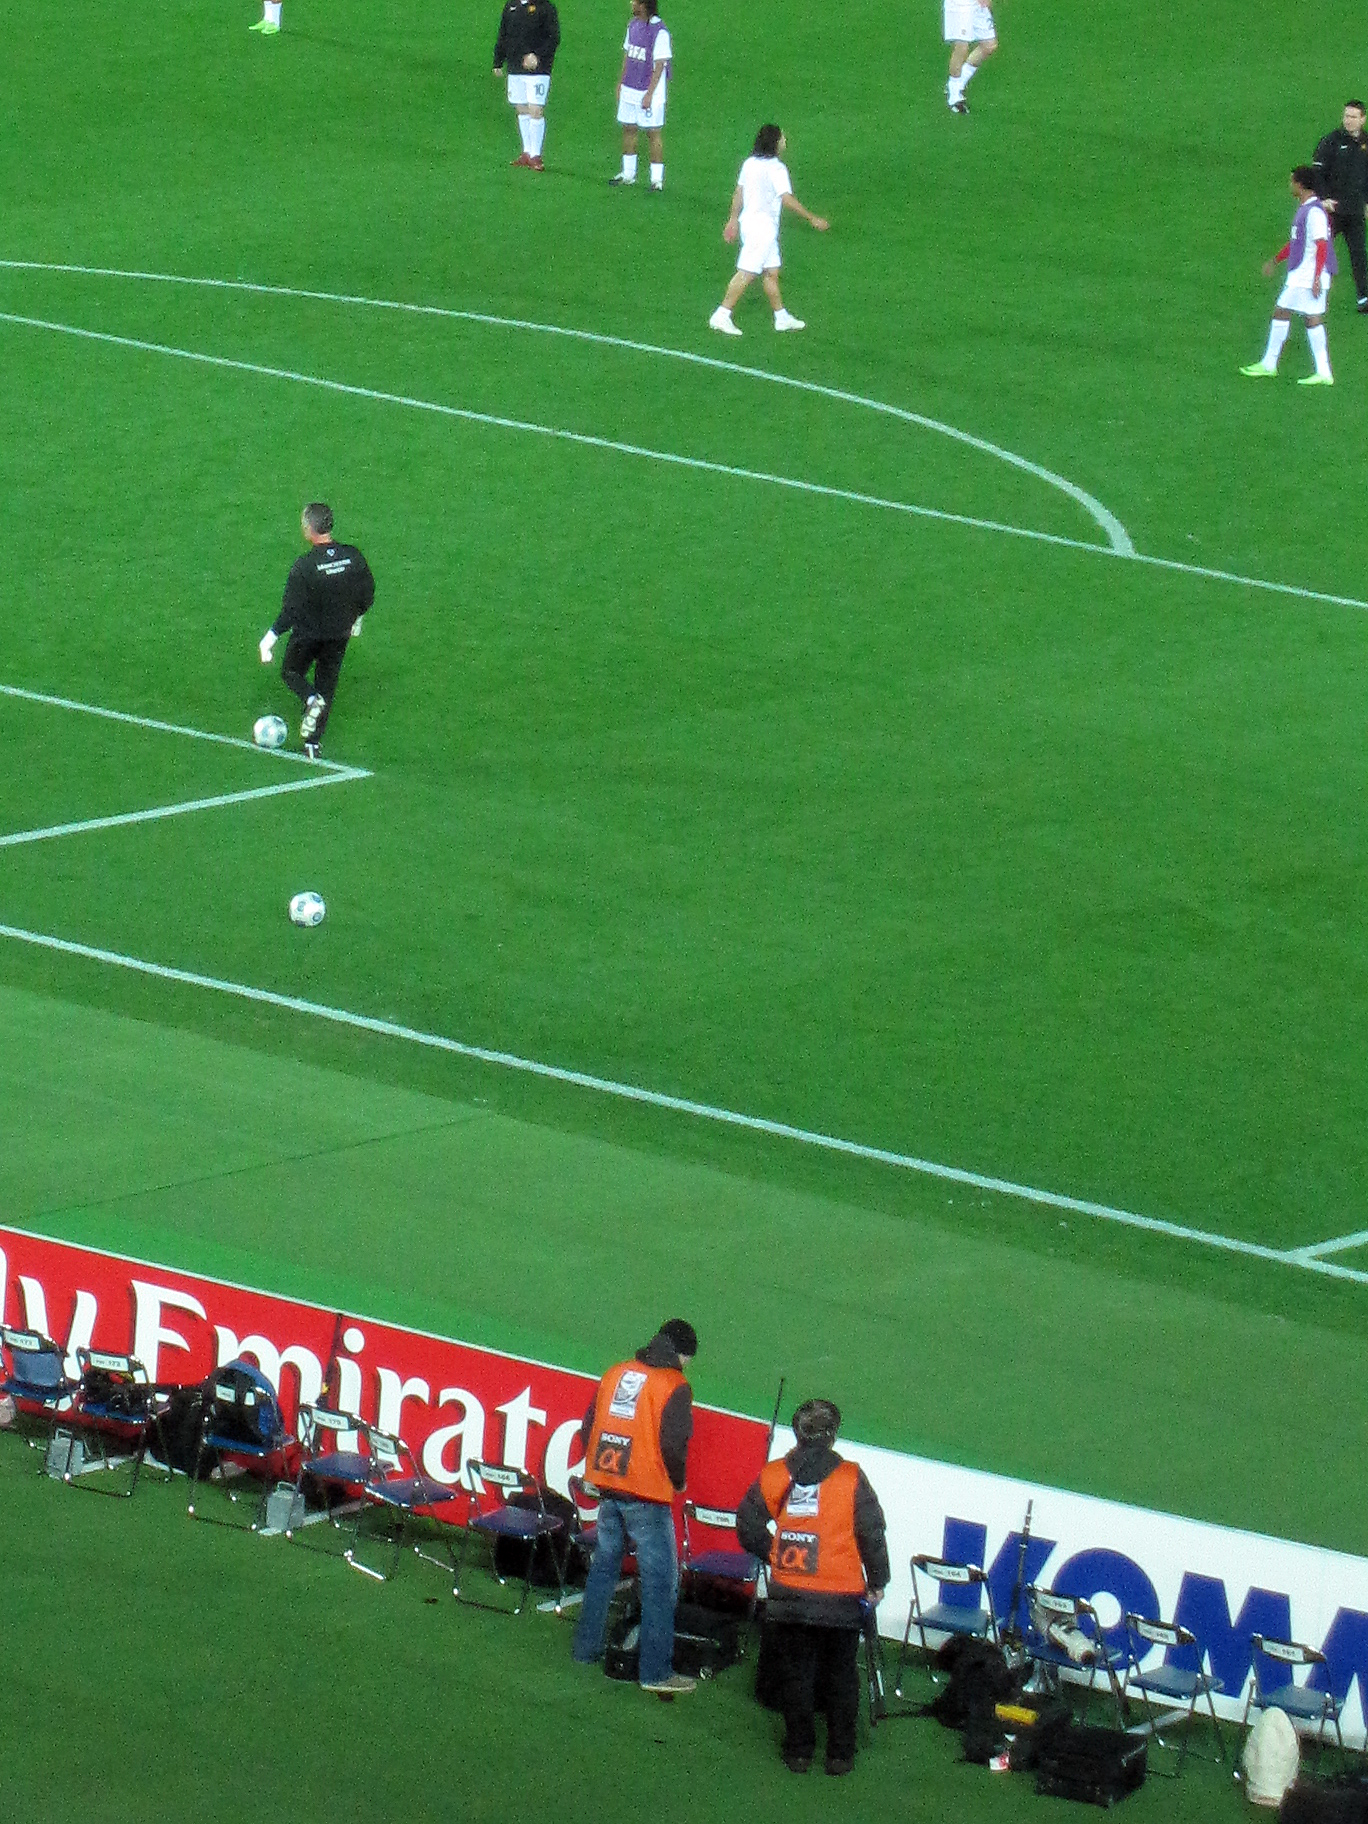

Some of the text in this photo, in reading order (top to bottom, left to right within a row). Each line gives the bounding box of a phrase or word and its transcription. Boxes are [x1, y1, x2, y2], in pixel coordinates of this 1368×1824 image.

[534, 83, 546, 96] 10
[130, 1279, 600, 1522] Emirate
[600, 1432, 632, 1447] SONY
[780, 1530, 817, 1543] SONY
